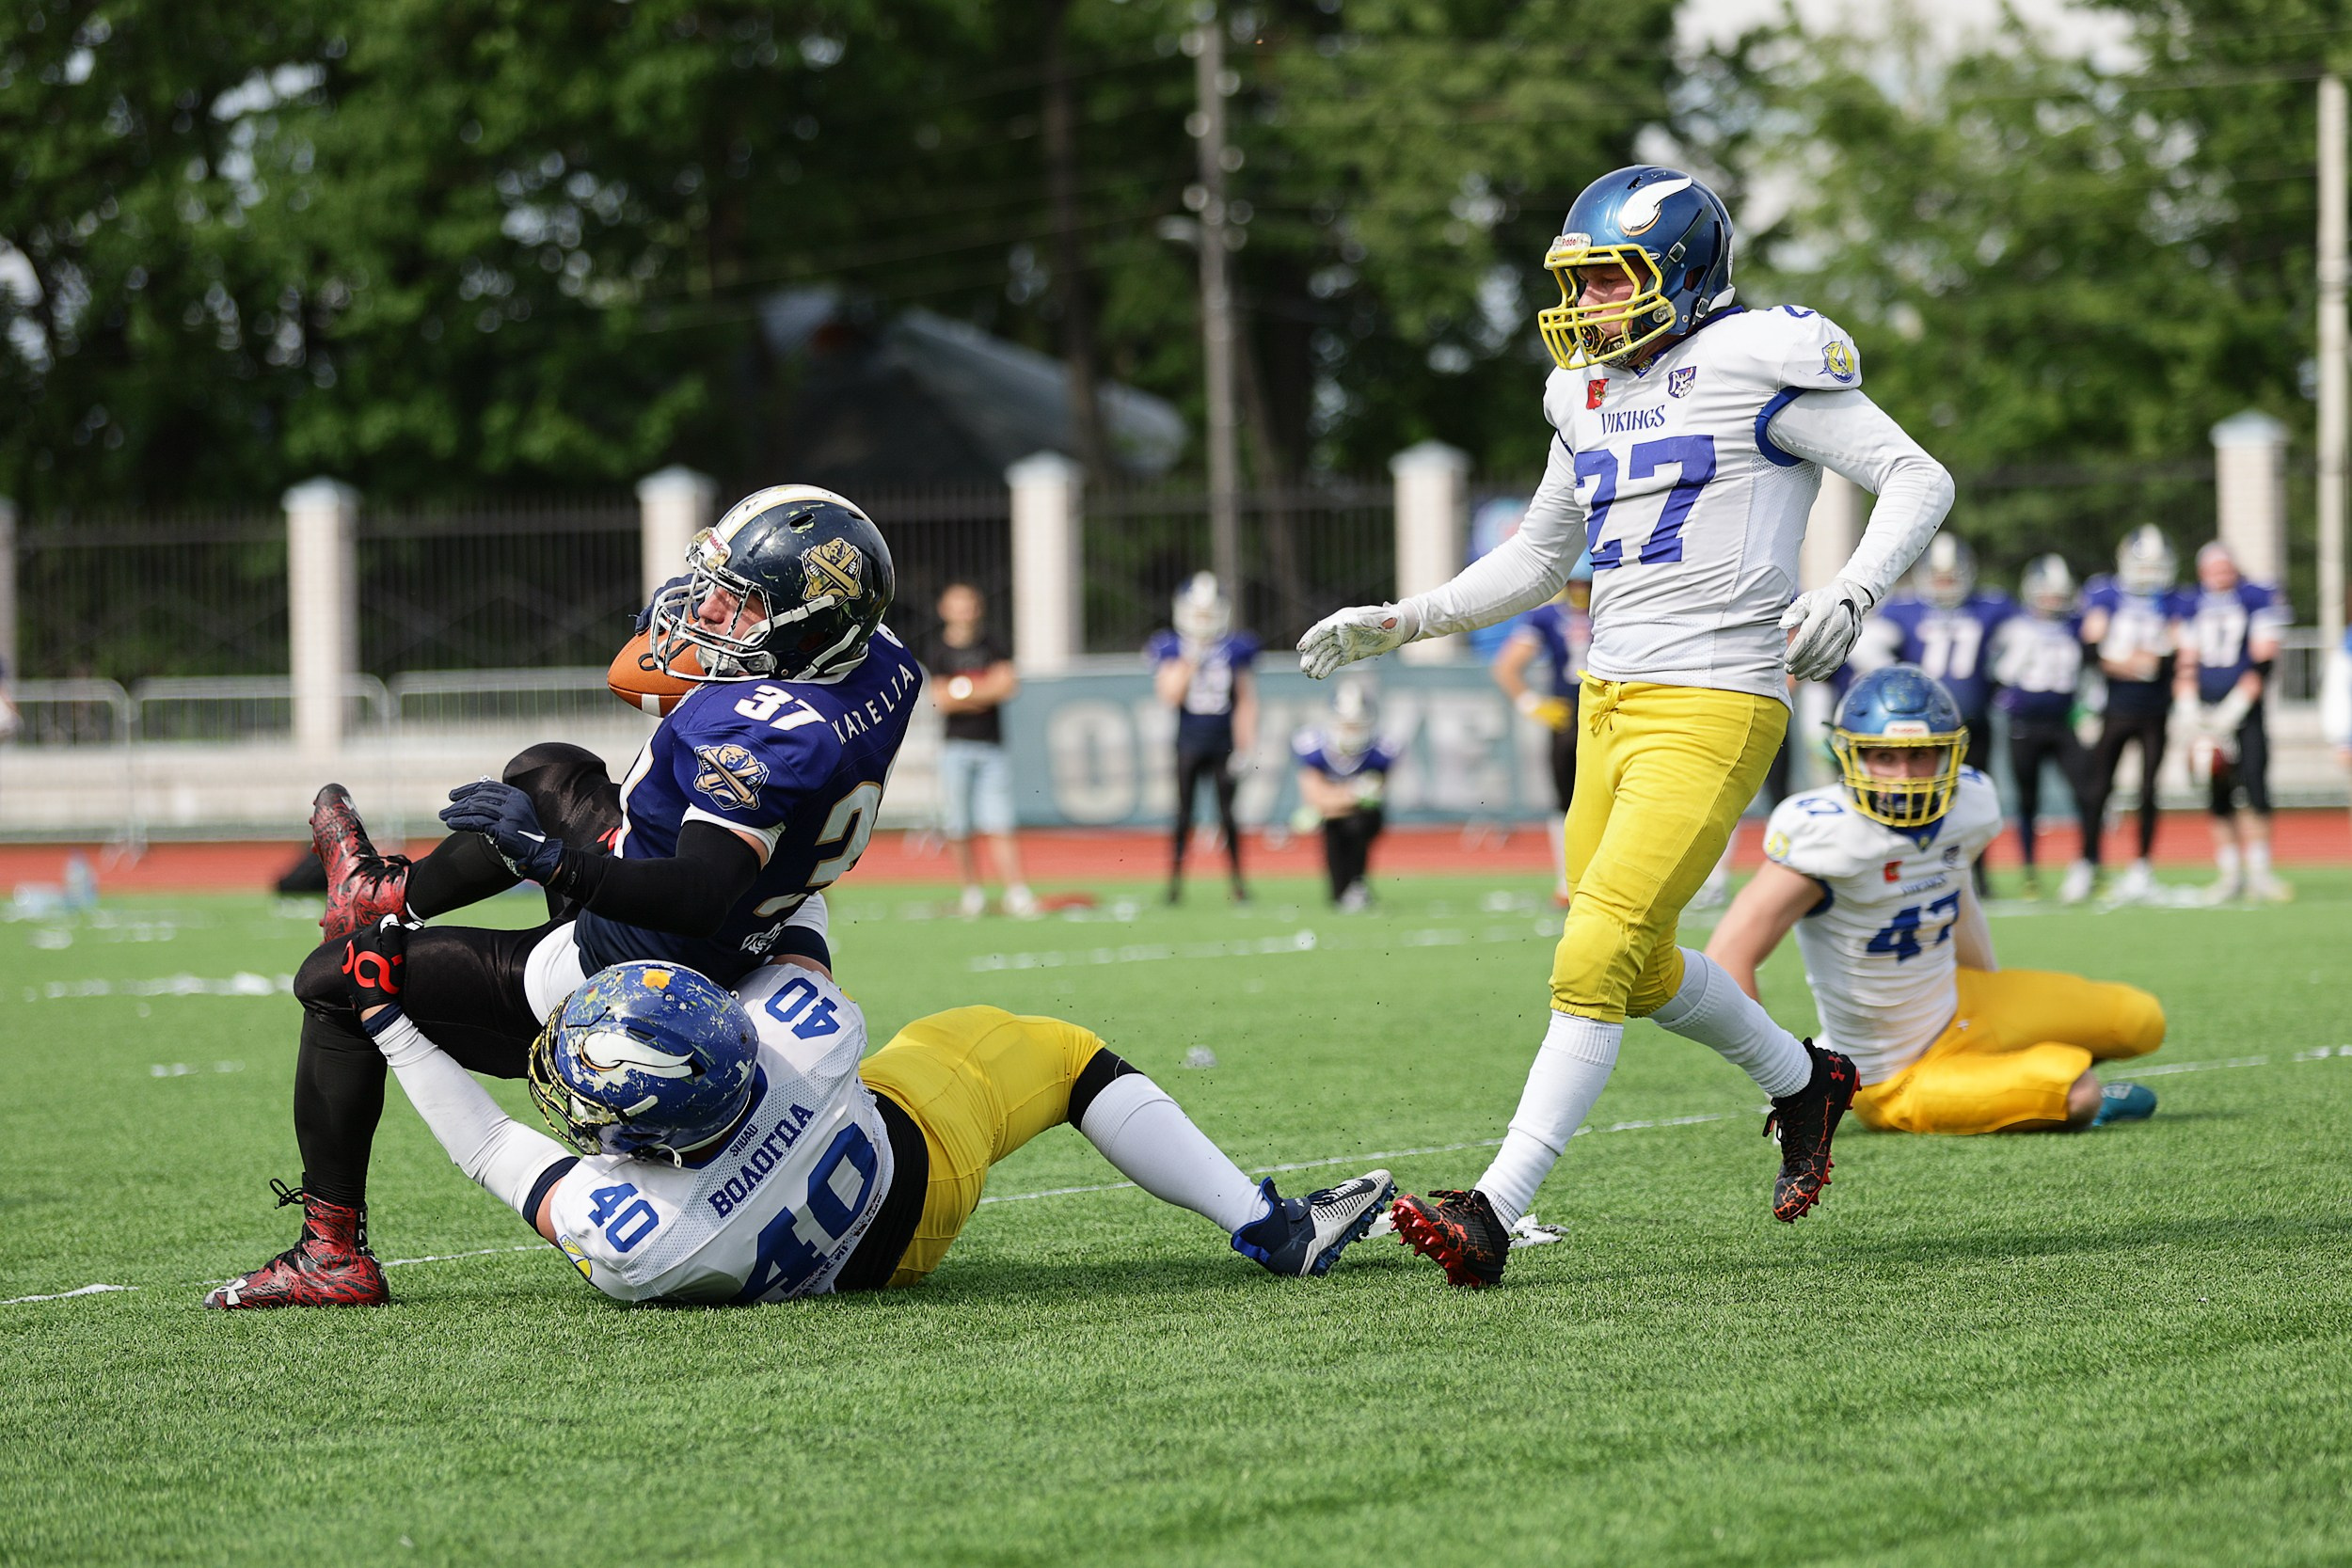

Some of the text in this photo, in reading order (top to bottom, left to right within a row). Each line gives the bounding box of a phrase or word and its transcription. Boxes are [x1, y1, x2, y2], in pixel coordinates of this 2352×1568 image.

[1601, 404, 1665, 436] VIKINGS
[1573, 435, 1716, 572] 27
[733, 684, 827, 731] 37
[832, 663, 915, 746] KARELIA
[1867, 889, 1961, 964] 47
[765, 977, 841, 1039] 40
[588, 1182, 660, 1253] 40
[730, 1121, 878, 1304] 40
